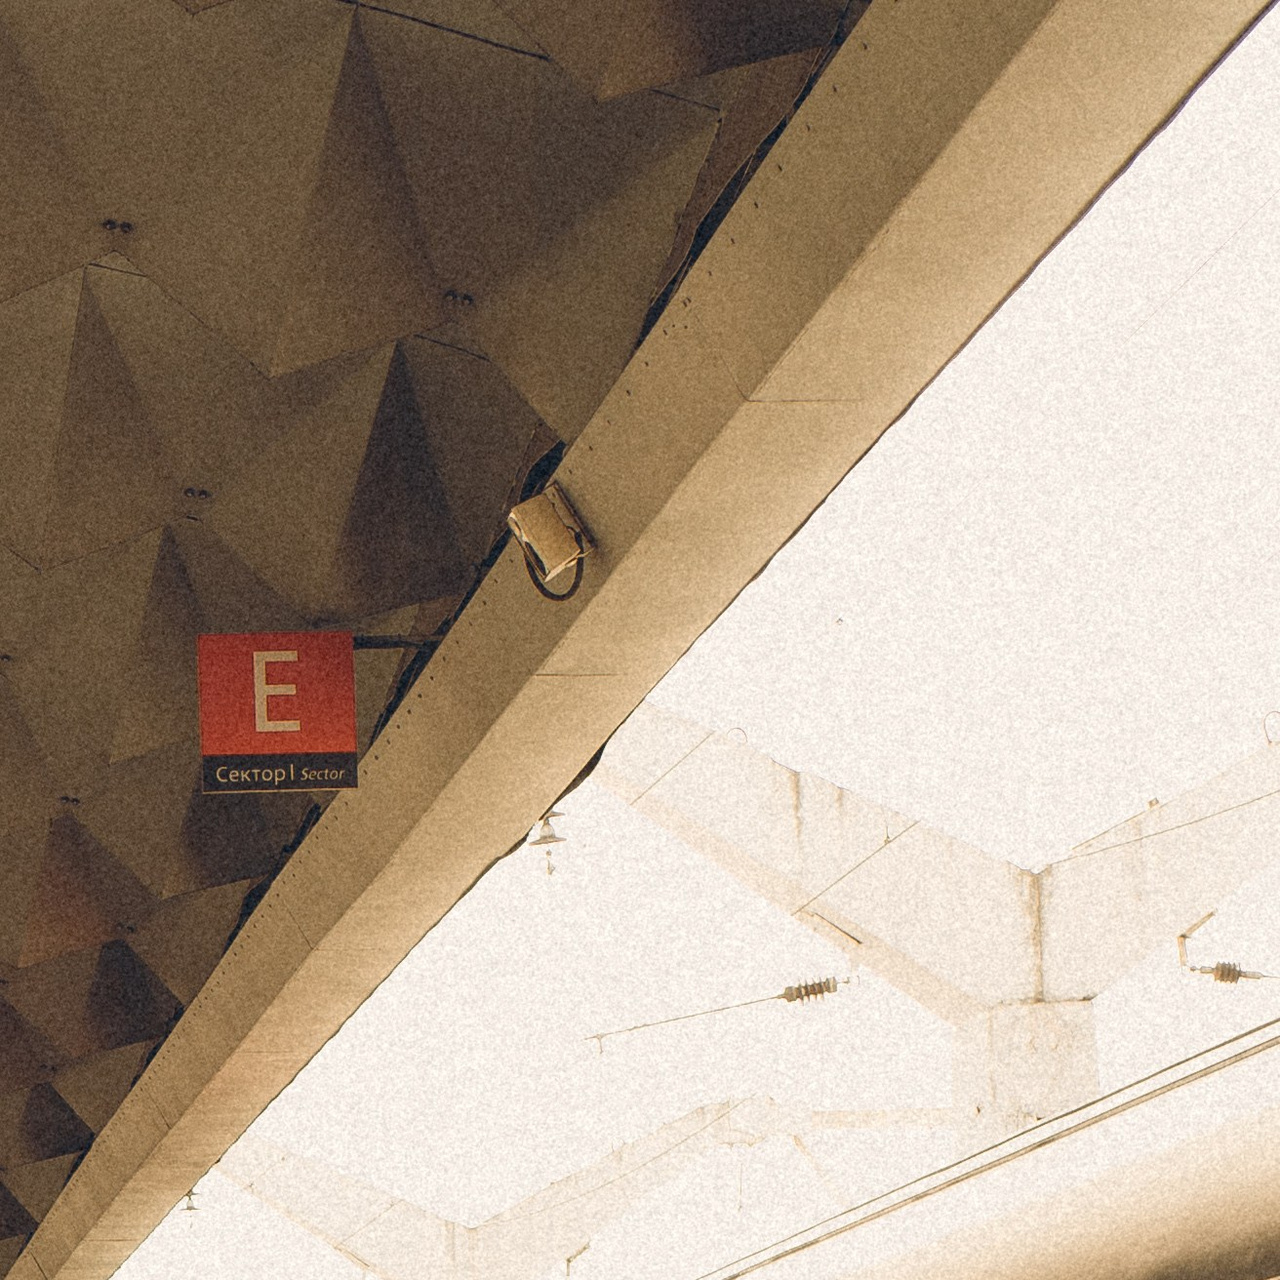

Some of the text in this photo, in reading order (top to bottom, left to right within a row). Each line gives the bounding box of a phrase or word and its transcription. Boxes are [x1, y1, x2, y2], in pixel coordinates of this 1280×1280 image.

[253, 651, 301, 732] E
[215, 766, 345, 786] Сектор Sector
